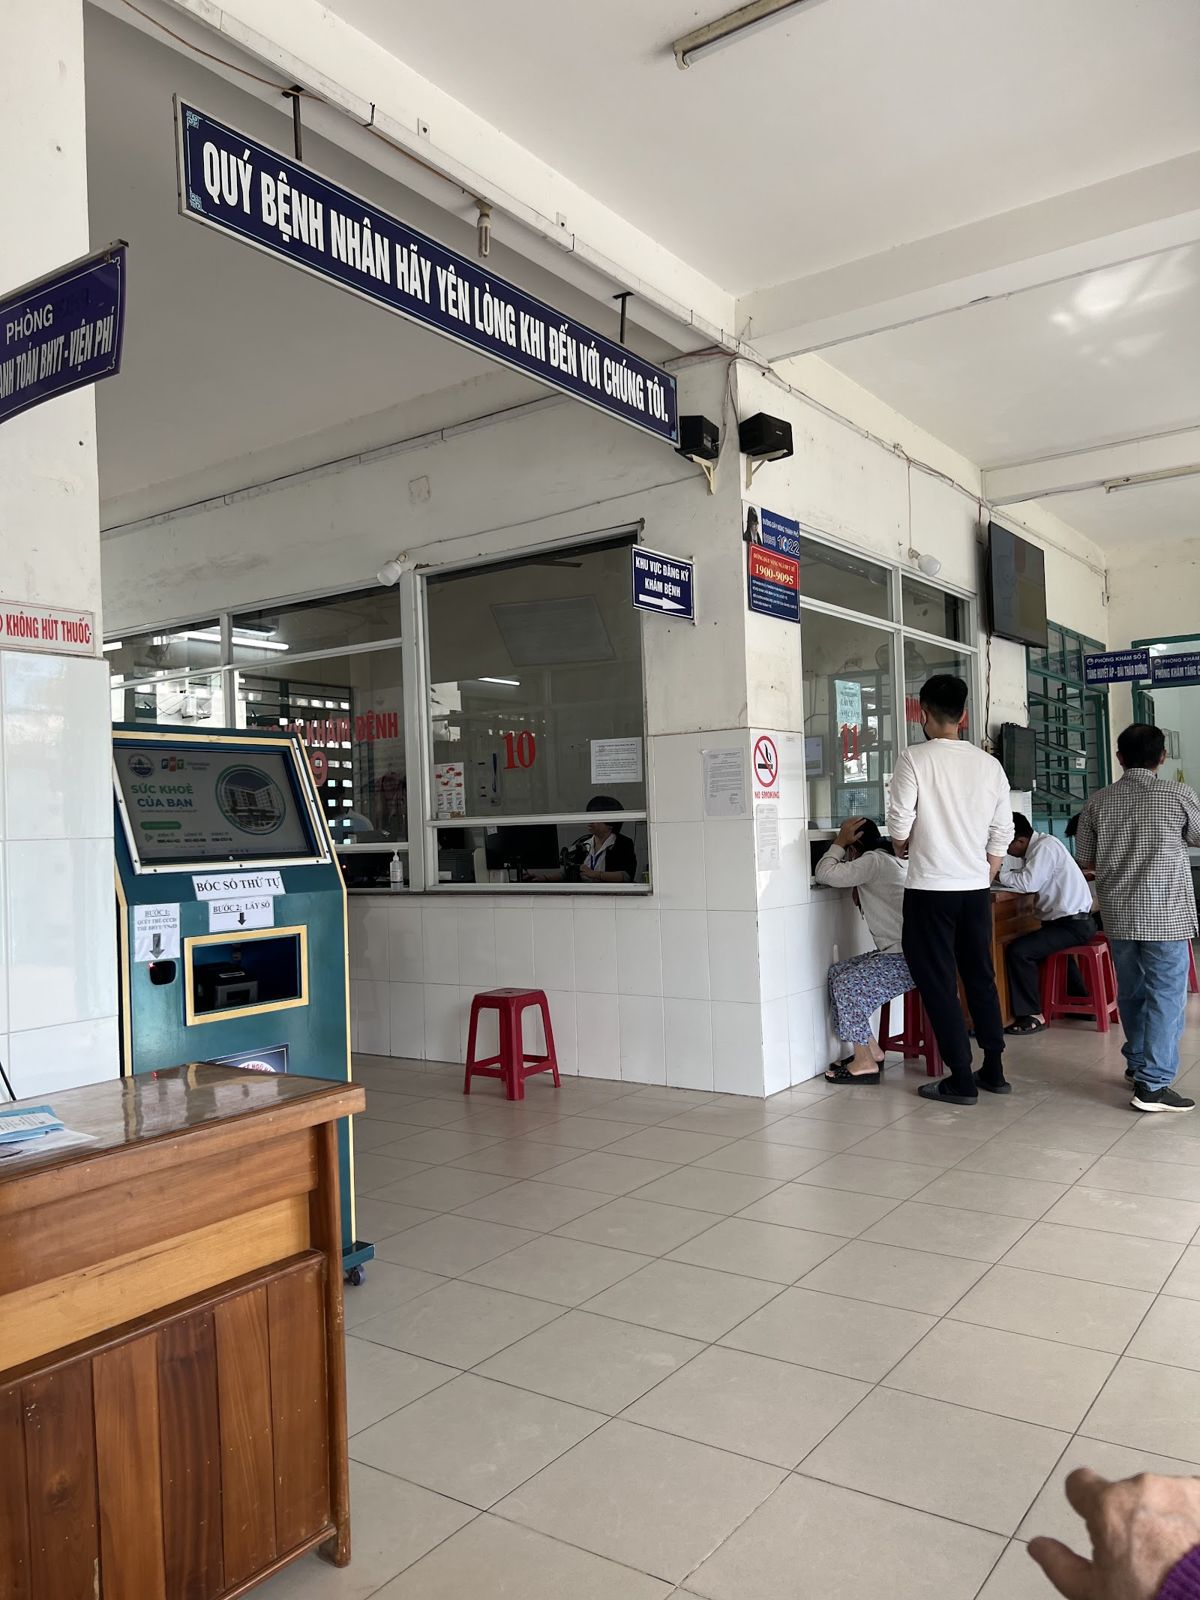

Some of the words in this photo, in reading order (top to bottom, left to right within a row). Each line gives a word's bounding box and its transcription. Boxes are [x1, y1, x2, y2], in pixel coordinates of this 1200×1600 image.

[202, 140, 252, 214] QUÝ
[260, 170, 324, 252] BỆNH
[330, 208, 391, 284] NHÂN
[396, 244, 432, 304] HÃY
[436, 264, 470, 325] YÊN
[474, 282, 517, 348] LÒNG
[520, 311, 546, 362] KHI
[549, 322, 578, 378] ĐẾN
[580, 340, 601, 390] VỚI
[603, 356, 644, 412] CHÚNG
[646, 375, 669, 422] TÔI.
[6, 304, 53, 344] PHÒNG
[16, 341, 39, 392] TOÁN
[40, 335, 65, 380] BHYT
[69, 318, 94, 372] VIỆN
[94, 306, 115, 358] PHÍ
[635, 556, 649, 571] KHU
[649, 560, 662, 576] VỰC
[662, 564, 680, 580] ĐĂNG
[680, 568, 689, 582] KÝ
[755, 564, 794, 585] 1900-9095
[644, 578, 663, 593] KHÁM
[664, 582, 681, 598] BỆNH
[6, 610, 39, 639] KHÔNG
[41, 614, 58, 640] HÚT
[61, 617, 90, 644] THUỐC
[306, 712, 350, 746] KHÁM
[840, 723, 860, 762] 11
[502, 730, 536, 770] 10
[310, 751, 328, 786] 9
[131, 782, 156, 794] SỨC
[137, 796, 164, 808] CỦA
[166, 798, 193, 809] BẠN
[222, 878, 238, 890] SỐ
[240, 876, 264, 889] THỨ
[265, 876, 281, 889] TỰ
